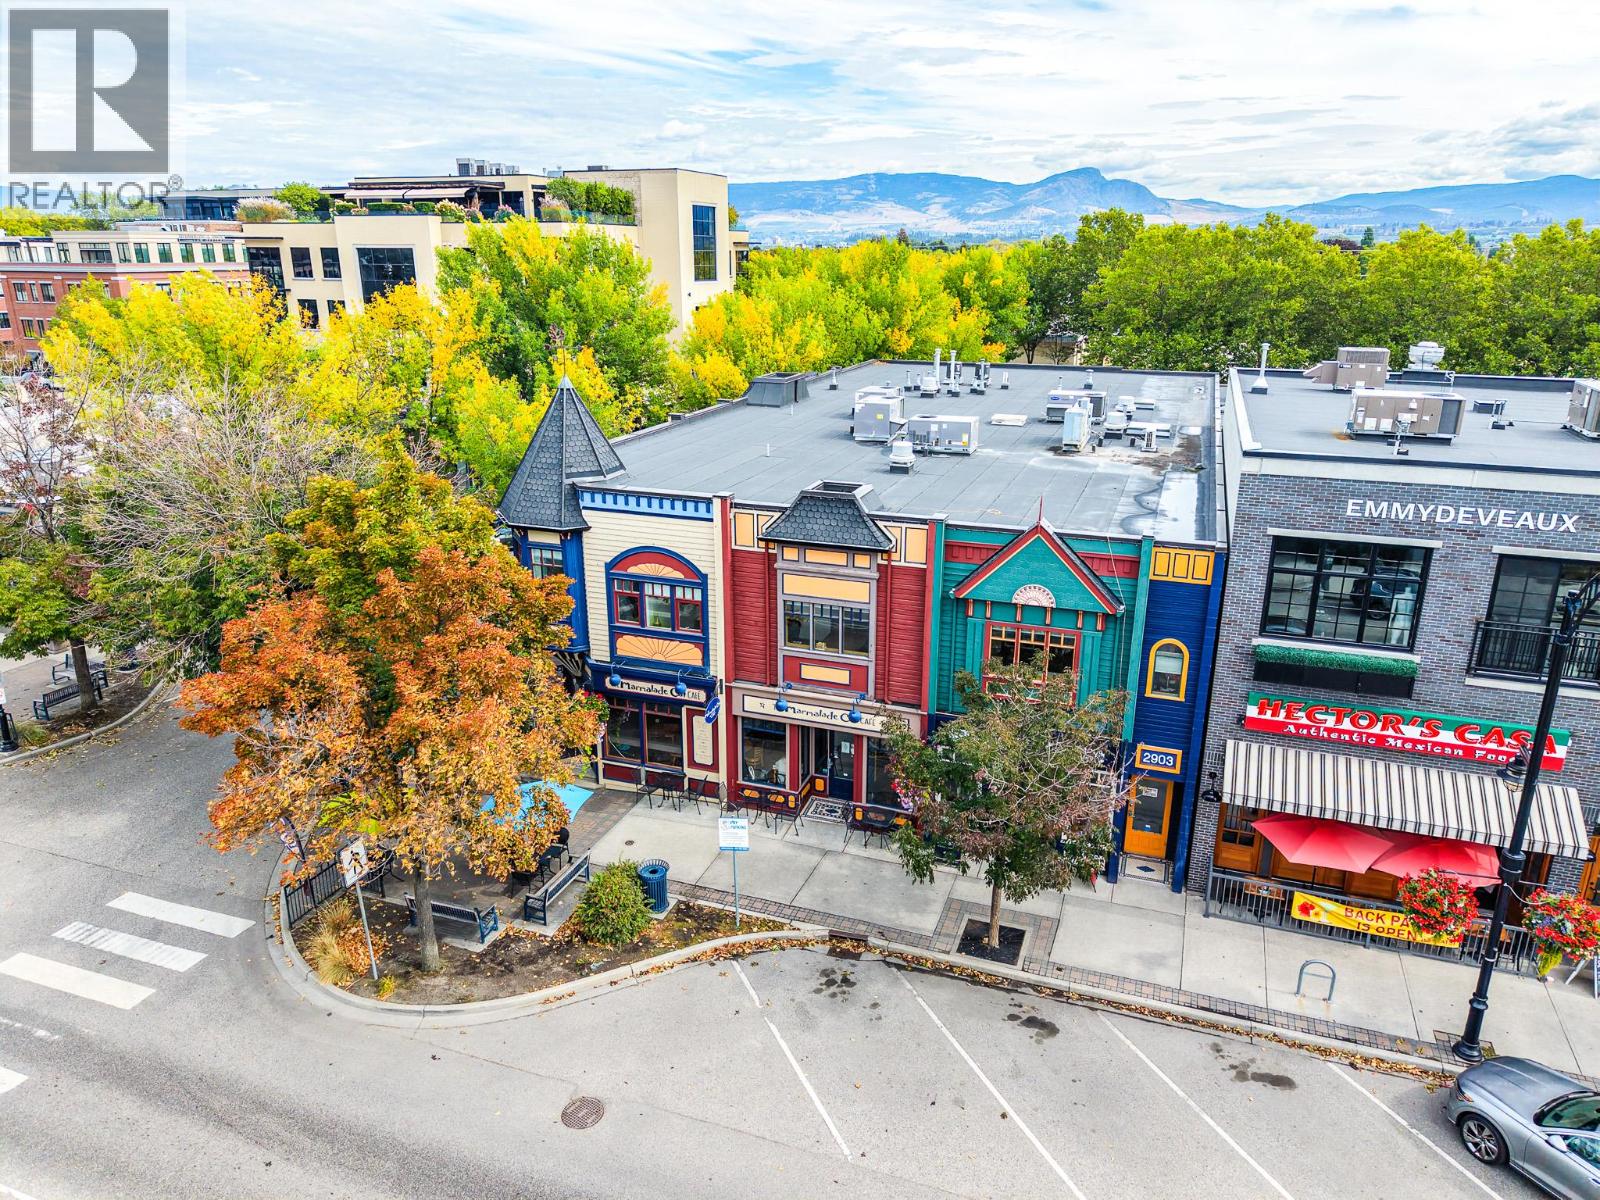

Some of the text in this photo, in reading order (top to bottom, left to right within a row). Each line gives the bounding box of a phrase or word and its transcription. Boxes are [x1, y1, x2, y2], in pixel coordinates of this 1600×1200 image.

[1346, 499, 1580, 533] EMMYDEVEAUX
[1257, 698, 1443, 738] HECTOR'S
[1283, 725, 1377, 745] Authentic
[1385, 737, 1463, 756] Mexican
[1142, 752, 1174, 767] 2903
[1344, 907, 1386, 925] BACK
[1356, 922, 1371, 932] IS
[1375, 926, 1417, 943] OPEN
